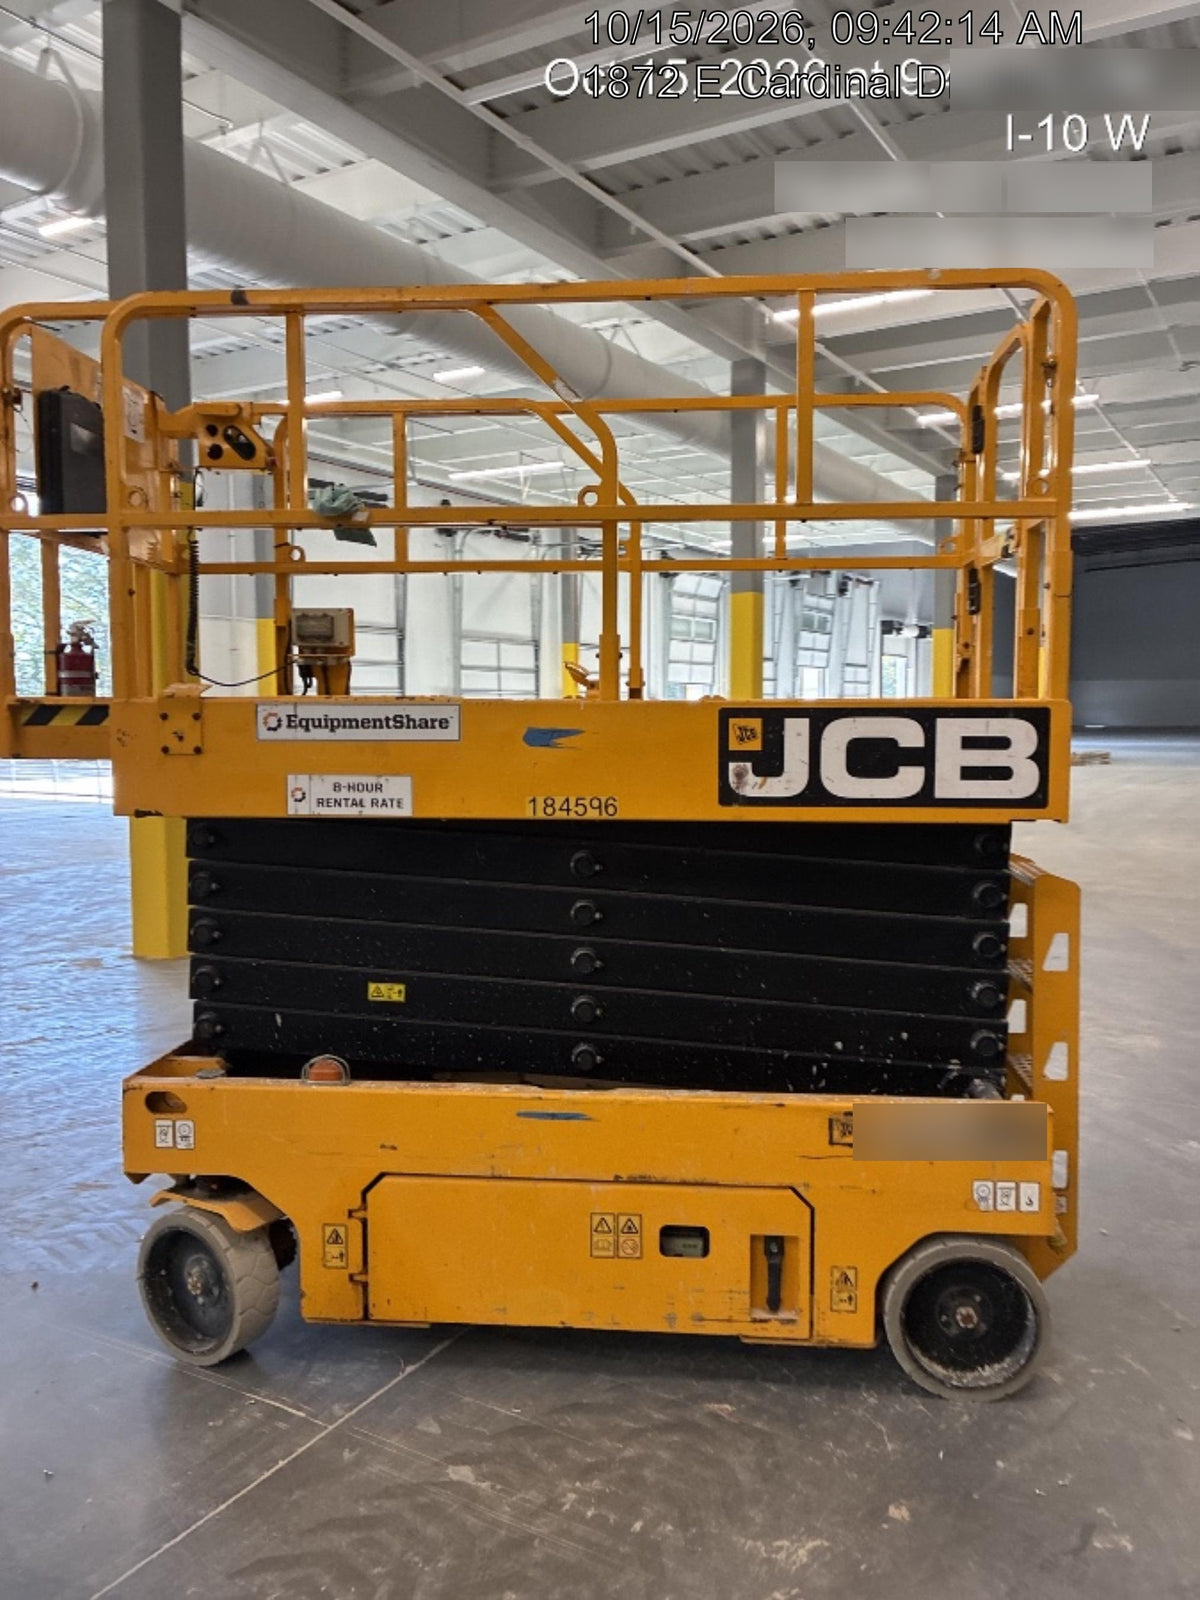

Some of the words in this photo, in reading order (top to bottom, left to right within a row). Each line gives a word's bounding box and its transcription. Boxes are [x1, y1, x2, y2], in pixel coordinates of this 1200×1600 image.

[286, 714, 450, 732] EquipmentShare
[729, 717, 1040, 799] JCB
[316, 798, 366, 808] RENTAL
[370, 798, 404, 809] RATE
[528, 796, 618, 816] 184596
